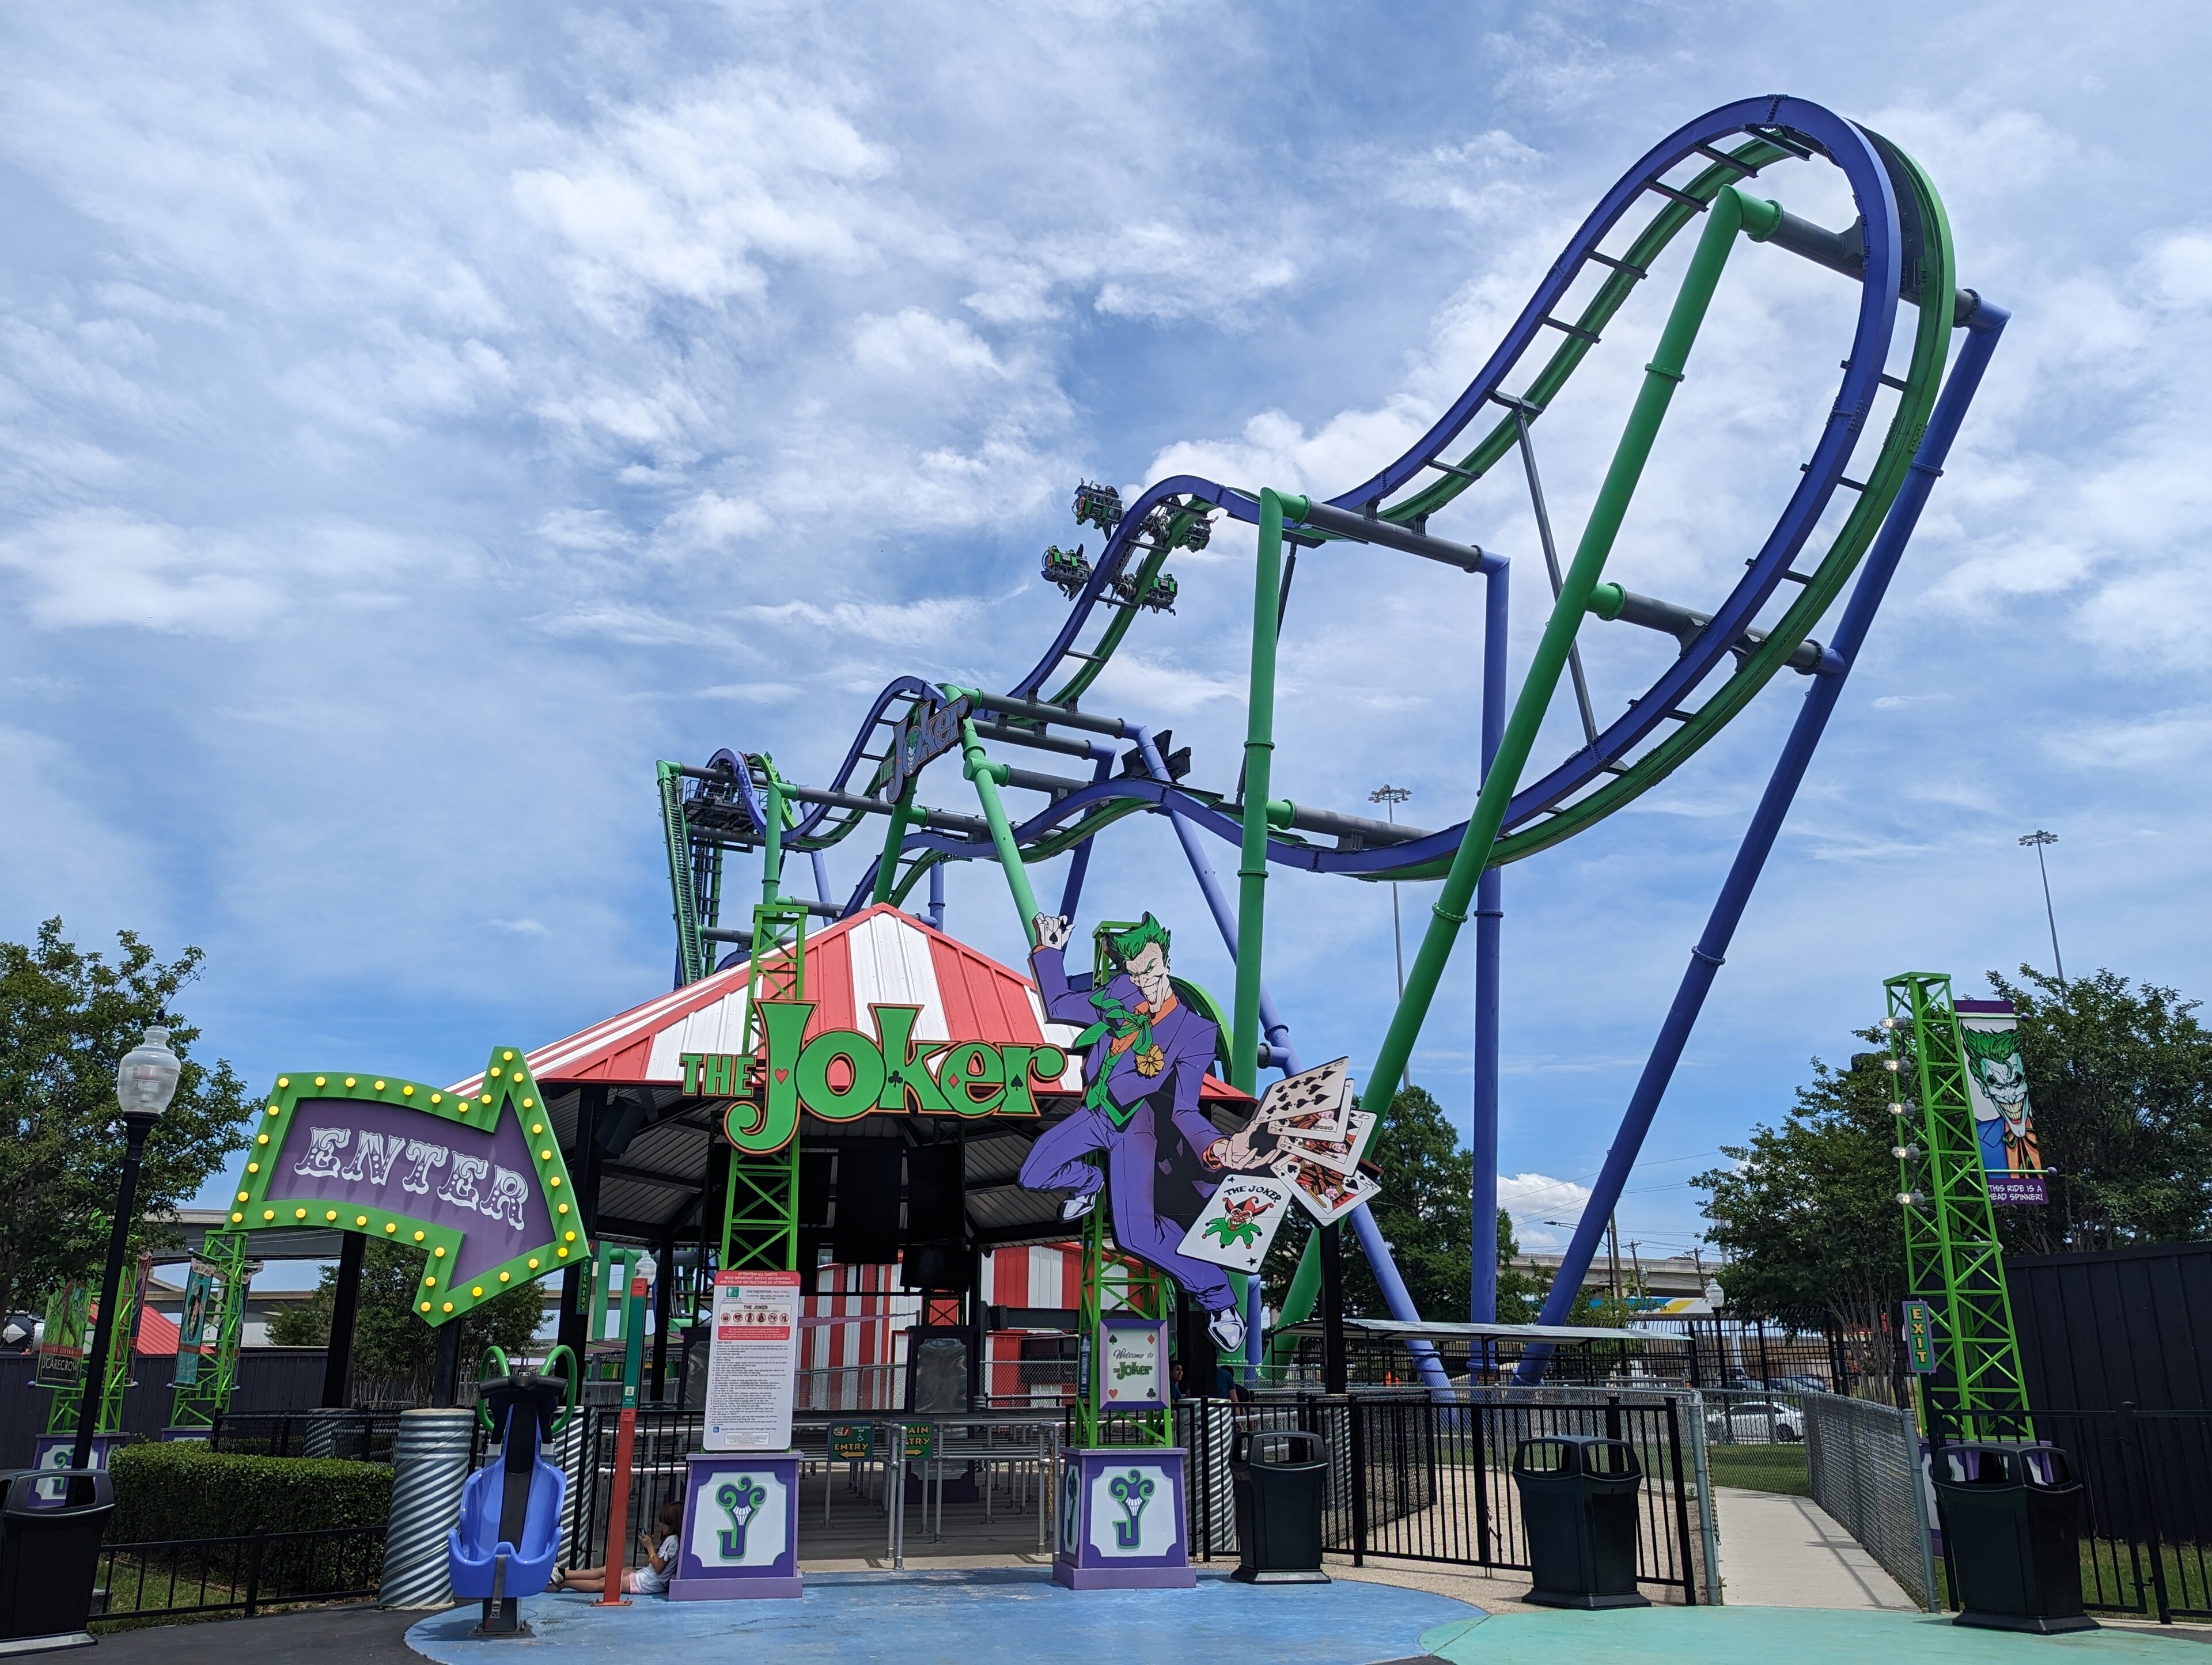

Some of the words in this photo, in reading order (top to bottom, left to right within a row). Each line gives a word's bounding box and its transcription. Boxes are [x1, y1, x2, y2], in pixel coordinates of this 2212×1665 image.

[886, 695, 969, 805] Joker
[879, 754, 895, 786] THE
[680, 1052, 757, 1098] THE
[723, 998, 1067, 1155] Joker
[294, 1127, 529, 1230] ENTER
[1224, 1185, 1247, 1196] THE
[1248, 1185, 1282, 1203] JOKER
[2009, 1193, 2043, 1201] SPINNER!
[580, 1275, 588, 1311] ENTRY
[1911, 1307, 1927, 1364] EXIT
[42, 1357, 78, 1372] SCARECROW
[1113, 1348, 1144, 1359] Welcome
[1116, 1361, 1153, 1380] Joker
[906, 1426, 929, 1434] AIN
